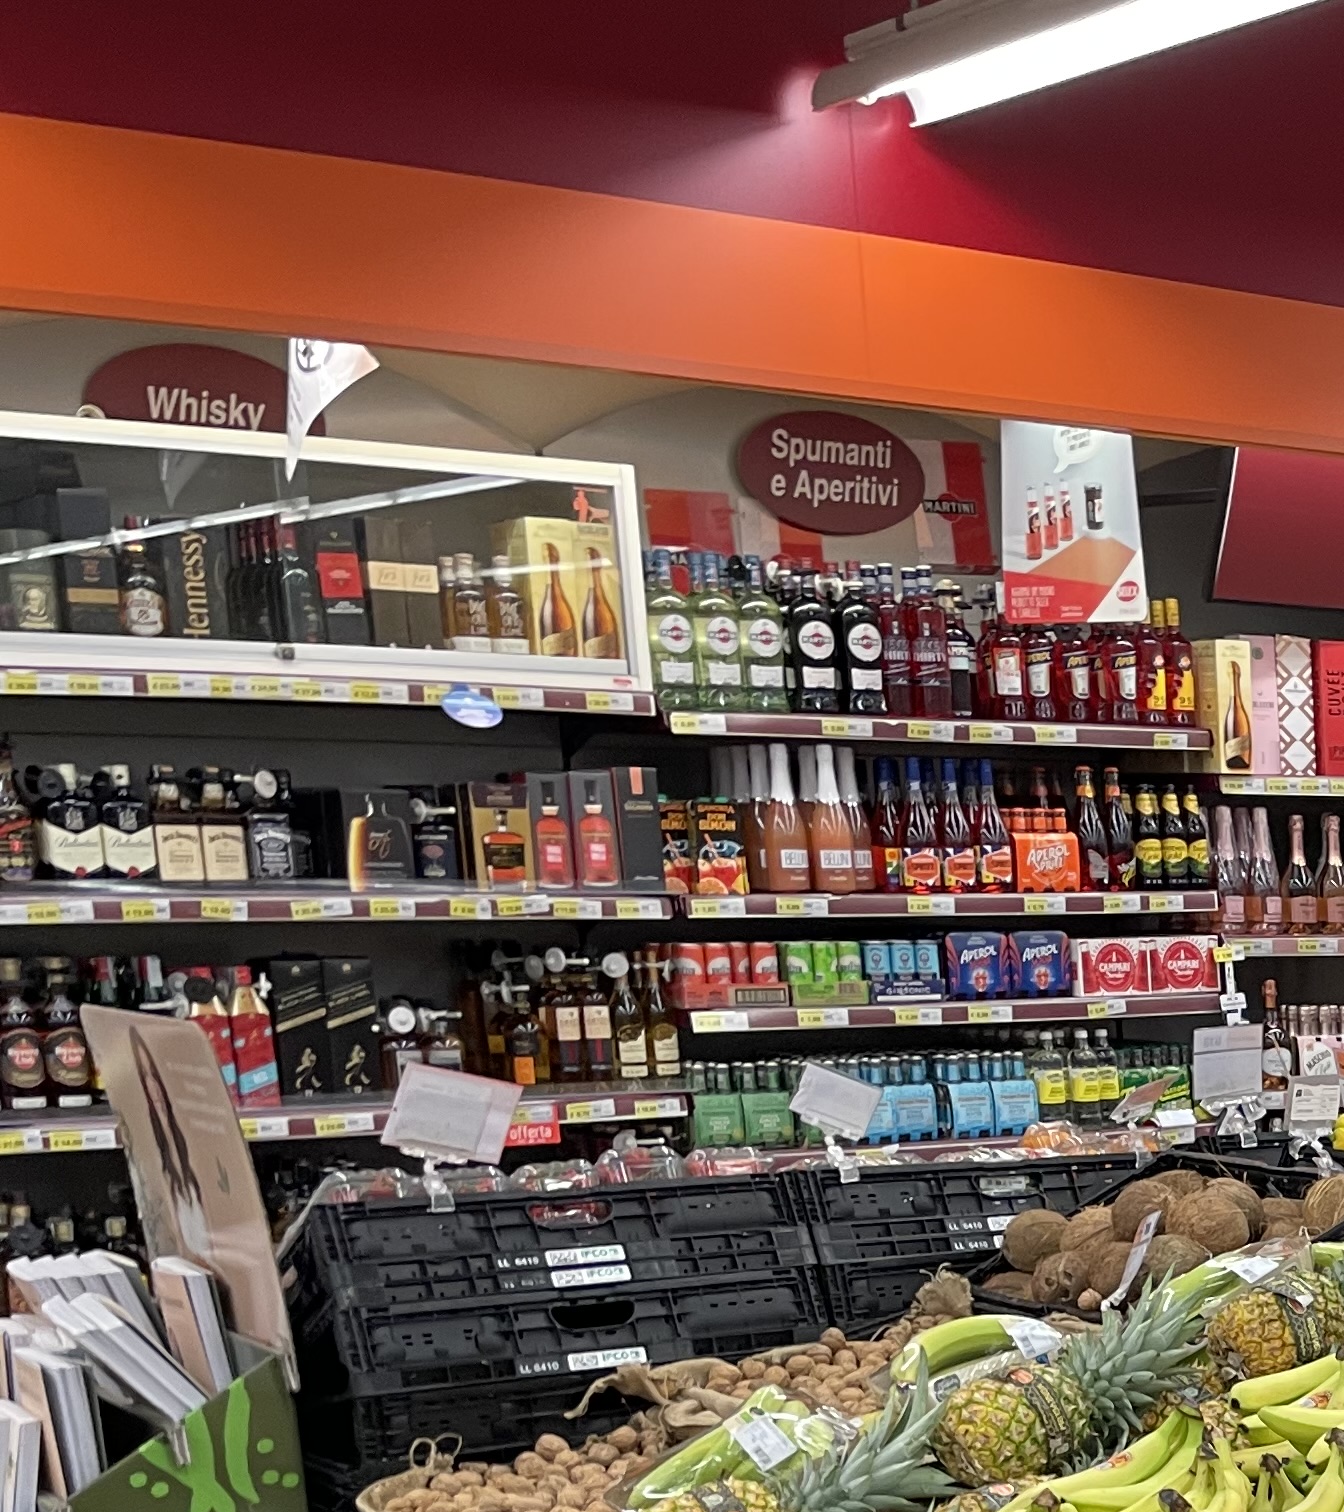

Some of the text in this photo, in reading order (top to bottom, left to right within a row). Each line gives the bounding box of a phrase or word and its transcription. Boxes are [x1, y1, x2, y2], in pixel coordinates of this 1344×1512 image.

[147, 385, 266, 432] Whisky
[771, 429, 892, 469] Spumanti
[771, 470, 899, 506] e Aperitivi
[924, 498, 977, 515] MARTINI
[1327, 669, 1341, 716] CUVÉE
[1027, 844, 1070, 869] APEROL
[509, 1124, 552, 1142] offerta
